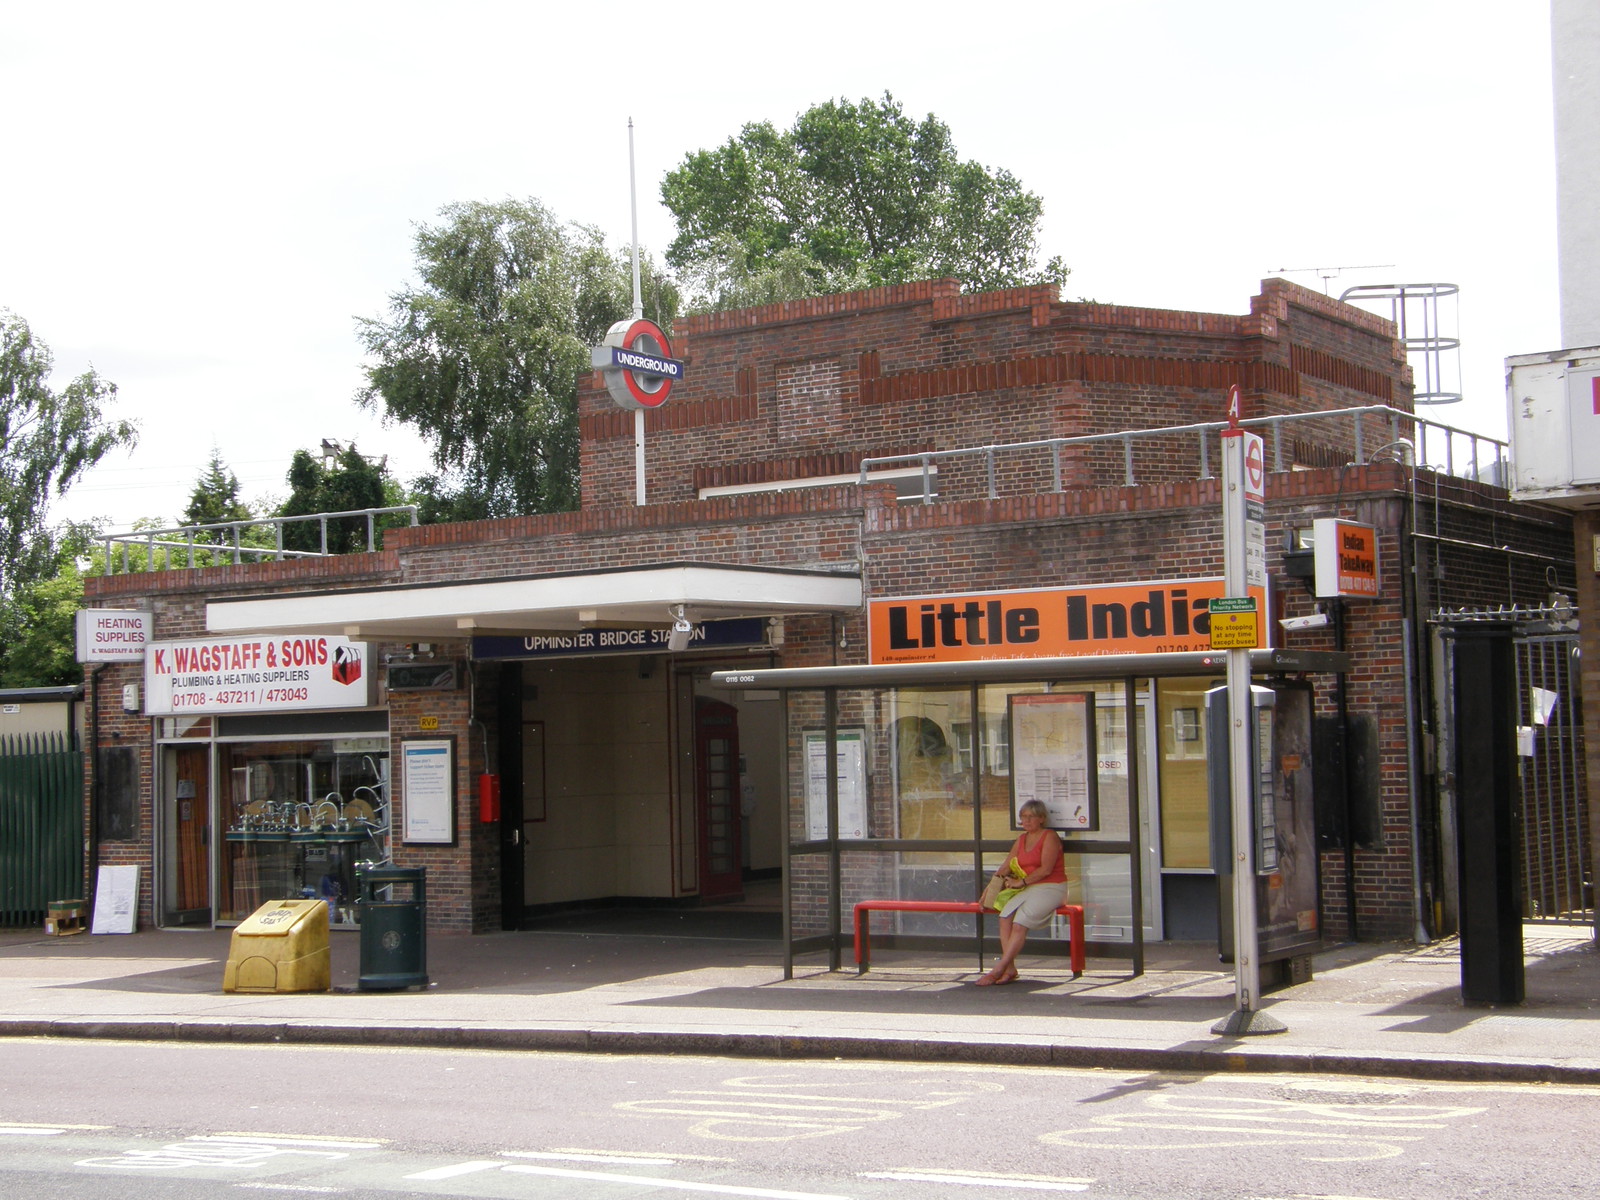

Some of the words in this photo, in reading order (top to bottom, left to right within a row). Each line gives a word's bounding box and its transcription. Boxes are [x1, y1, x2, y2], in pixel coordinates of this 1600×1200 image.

[617, 352, 677, 375] UNDERGROUND
[1229, 391, 1238, 418] A
[1343, 532, 1364, 551] Indian
[97, 618, 142, 628] HEATING
[889, 600, 1040, 650] Little
[95, 632, 145, 643] SUPPLIES
[525, 633, 594, 650] UPMINSTER
[600, 630, 646, 646] BRIDGE
[651, 626, 706, 644] STAON
[155, 649, 171, 675] K.
[174, 642, 261, 673] WAGSTAFF
[266, 641, 277, 668] &
[281, 637, 328, 667] SONS
[172, 675, 215, 688] PLUMBING
[216, 675, 222, 685] &
[223, 672, 260, 685] HEATING
[262, 670, 310, 683] SUPPLIERS
[173, 693, 206, 707] 01708
[216, 690, 255, 704] 437211
[266, 688, 308, 702] 473043
[422, 718, 437, 726] RVP
[1098, 760, 1122, 769] OSED
